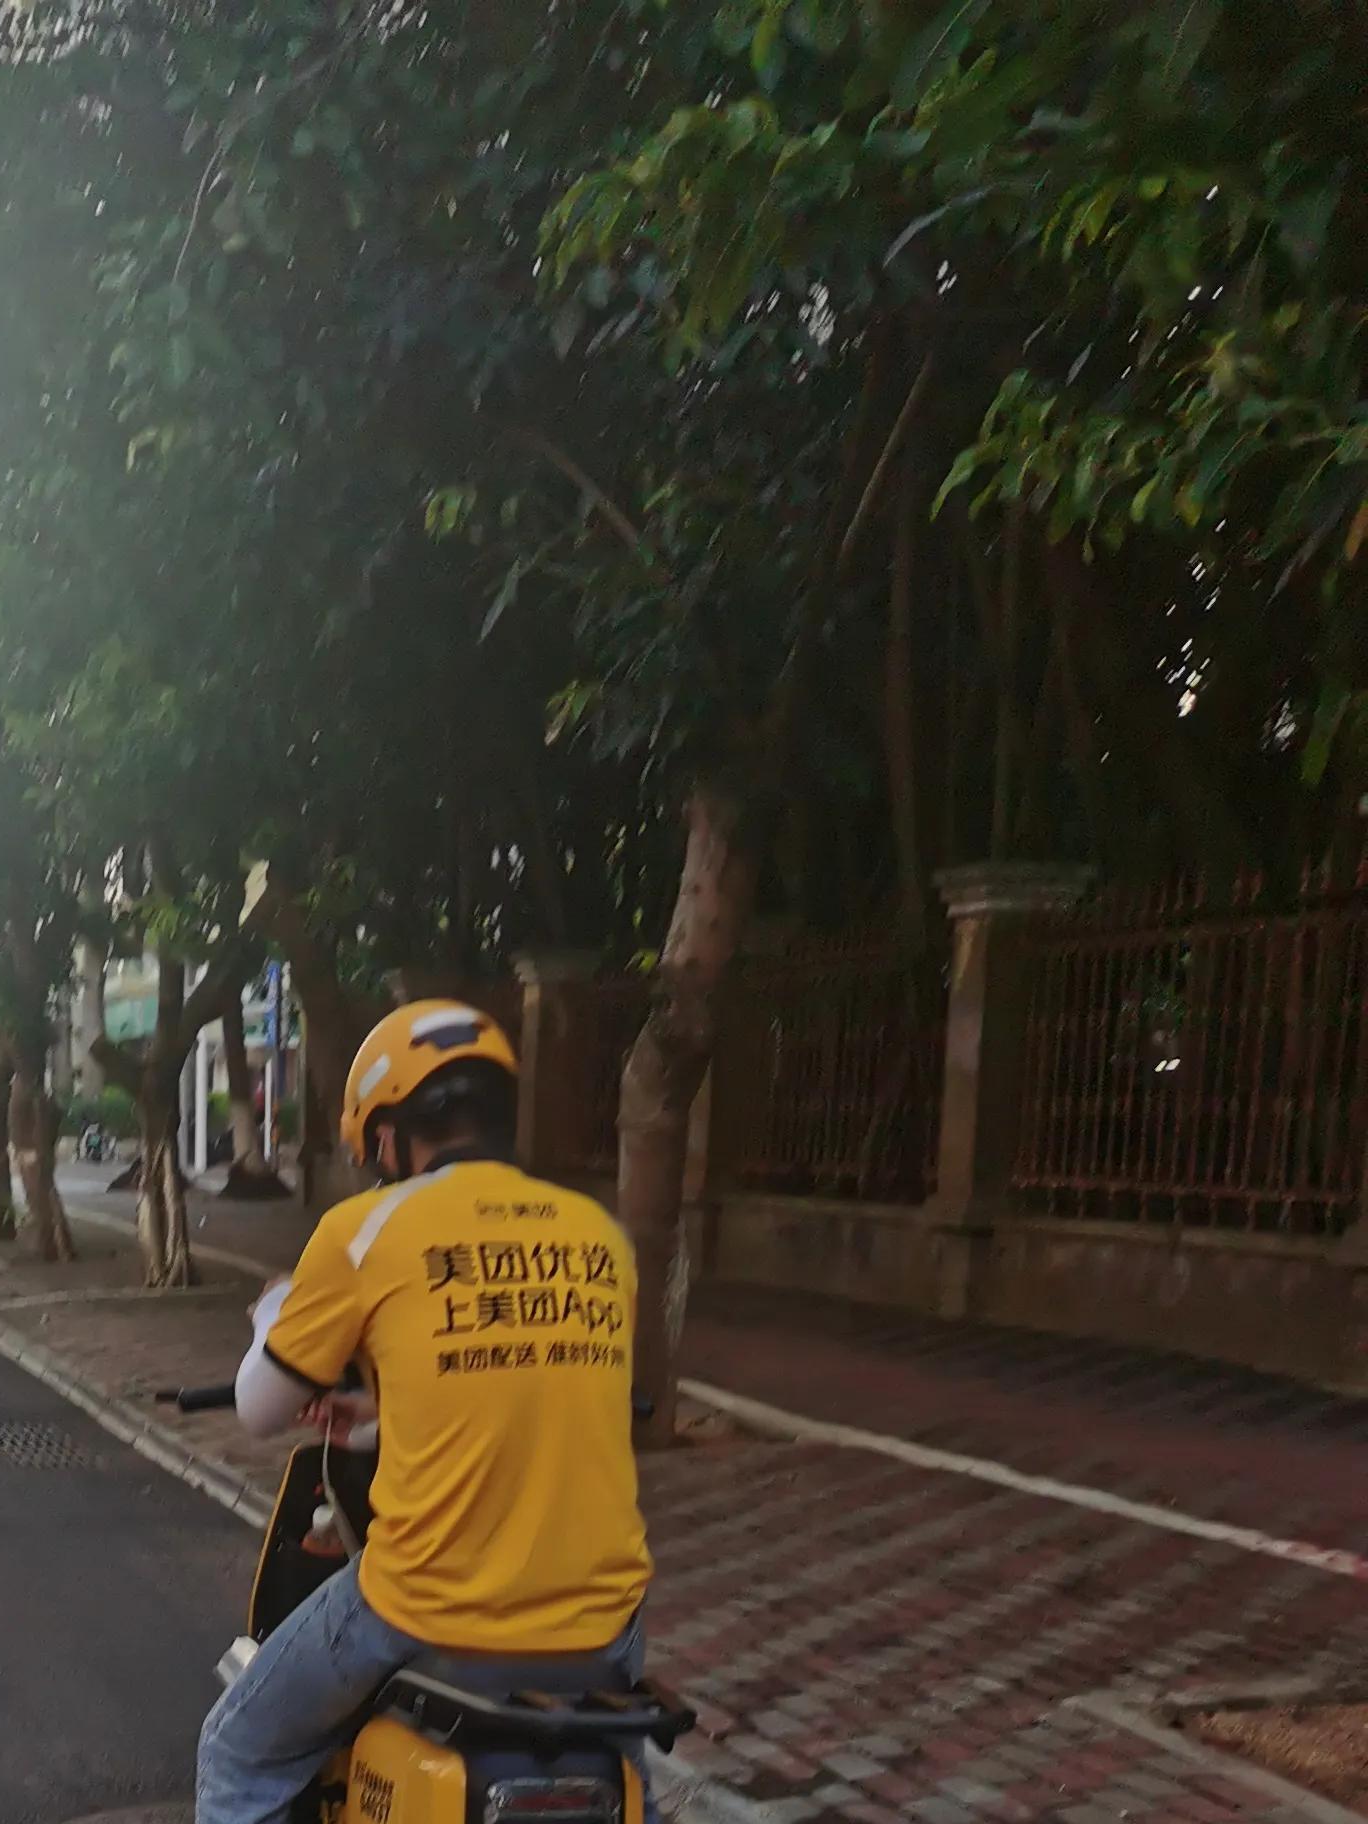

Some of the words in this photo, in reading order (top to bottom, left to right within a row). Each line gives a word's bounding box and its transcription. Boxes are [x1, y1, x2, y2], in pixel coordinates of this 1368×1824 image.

[422, 1241, 617, 1292] 美团优选
[432, 1287, 622, 1338] 上美团App
